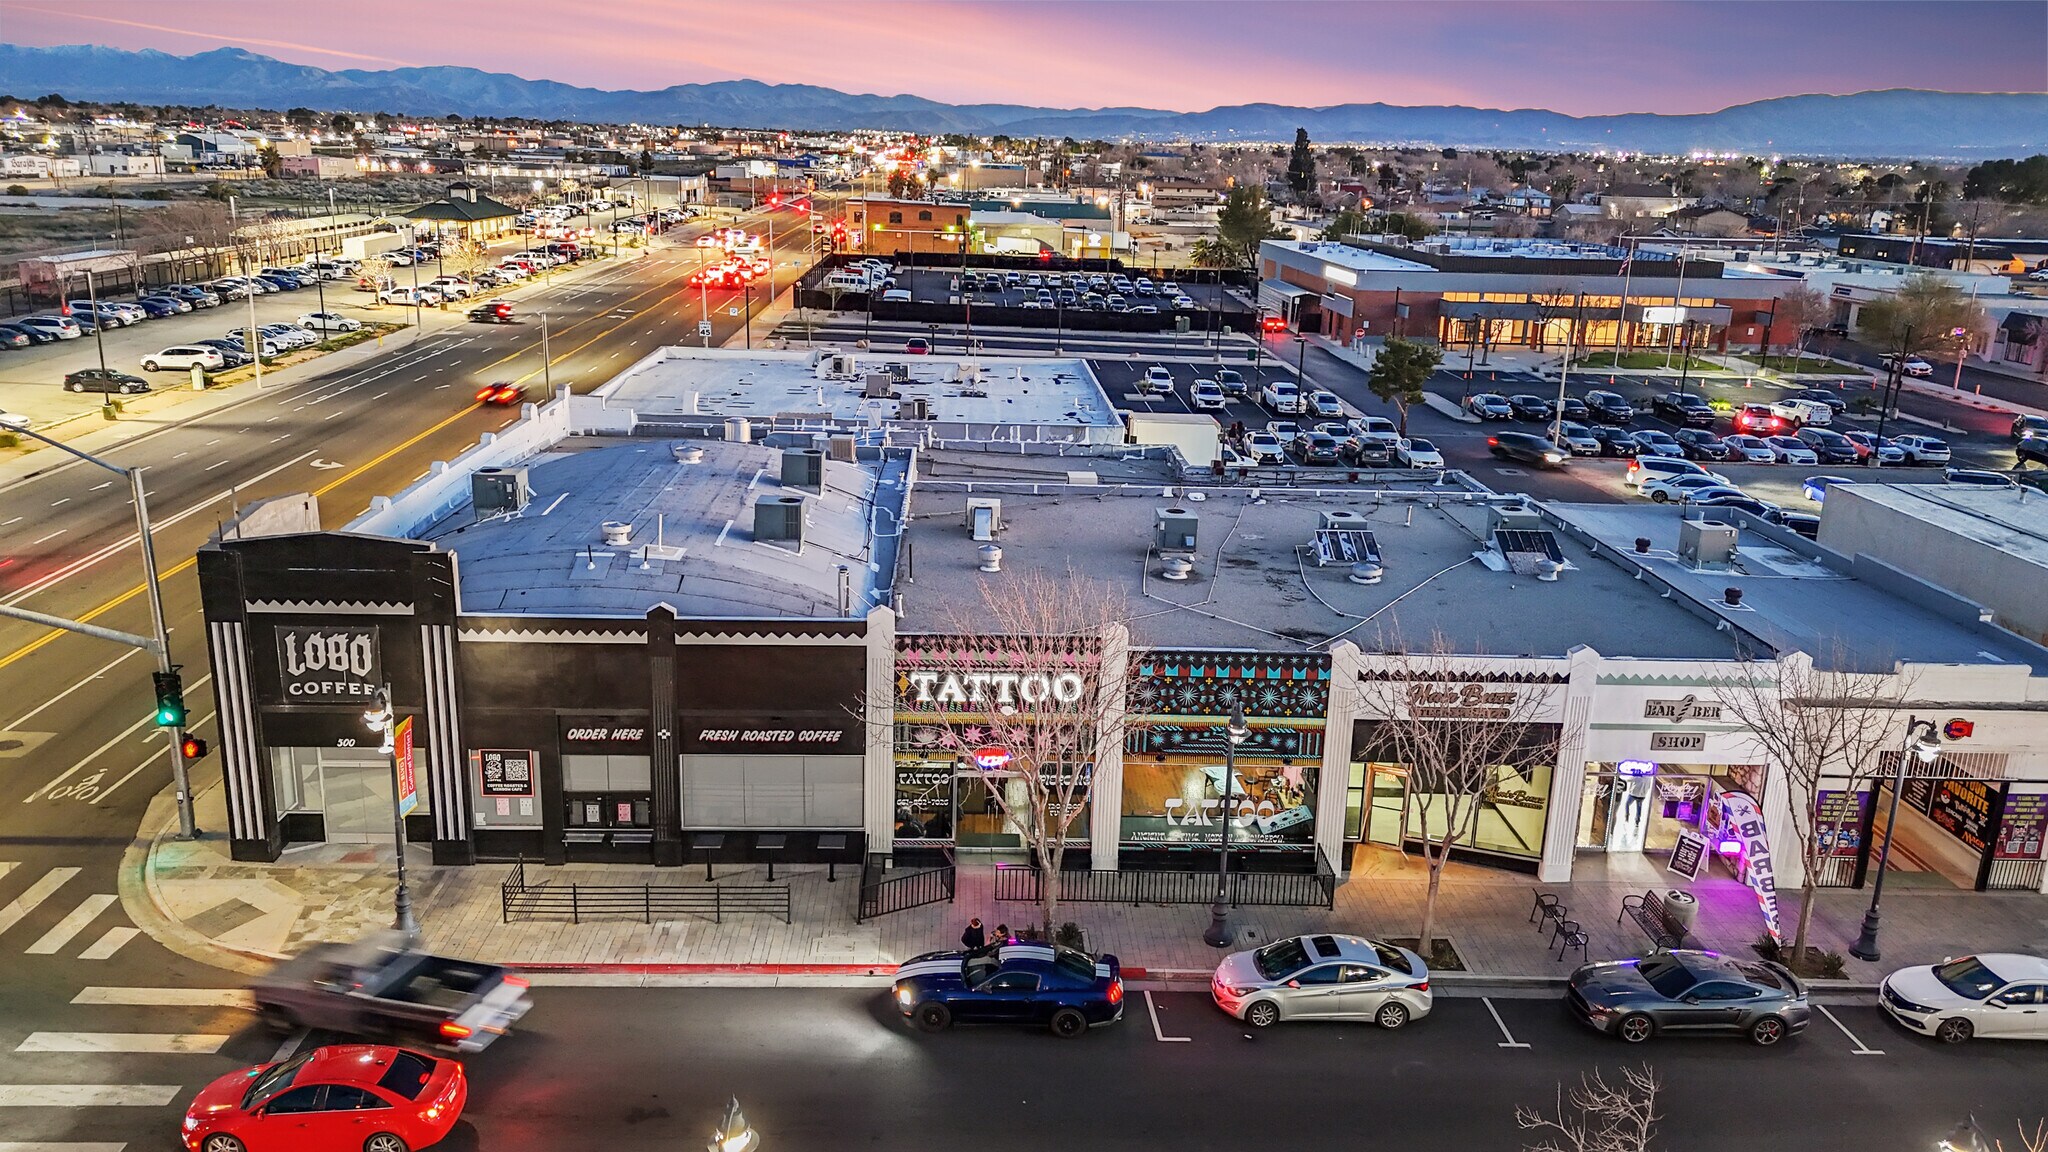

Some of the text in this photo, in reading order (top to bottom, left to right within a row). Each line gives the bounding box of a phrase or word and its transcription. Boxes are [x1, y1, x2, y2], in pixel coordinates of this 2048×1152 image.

[284, 631, 372, 677] LOBO
[910, 672, 1082, 703] TATTOO
[1406, 683, 1517, 707] Hair Buzz
[567, 728, 644, 741] ORDER HERE
[699, 729, 843, 743] FRESH ROASTED COFFEE
[337, 738, 356, 747] 500
[1657, 736, 1701, 748] SHOP
[485, 753, 501, 762] LOBO
[899, 773, 949, 785] TATTOO
[1943, 781, 1990, 815] FAVORITE
